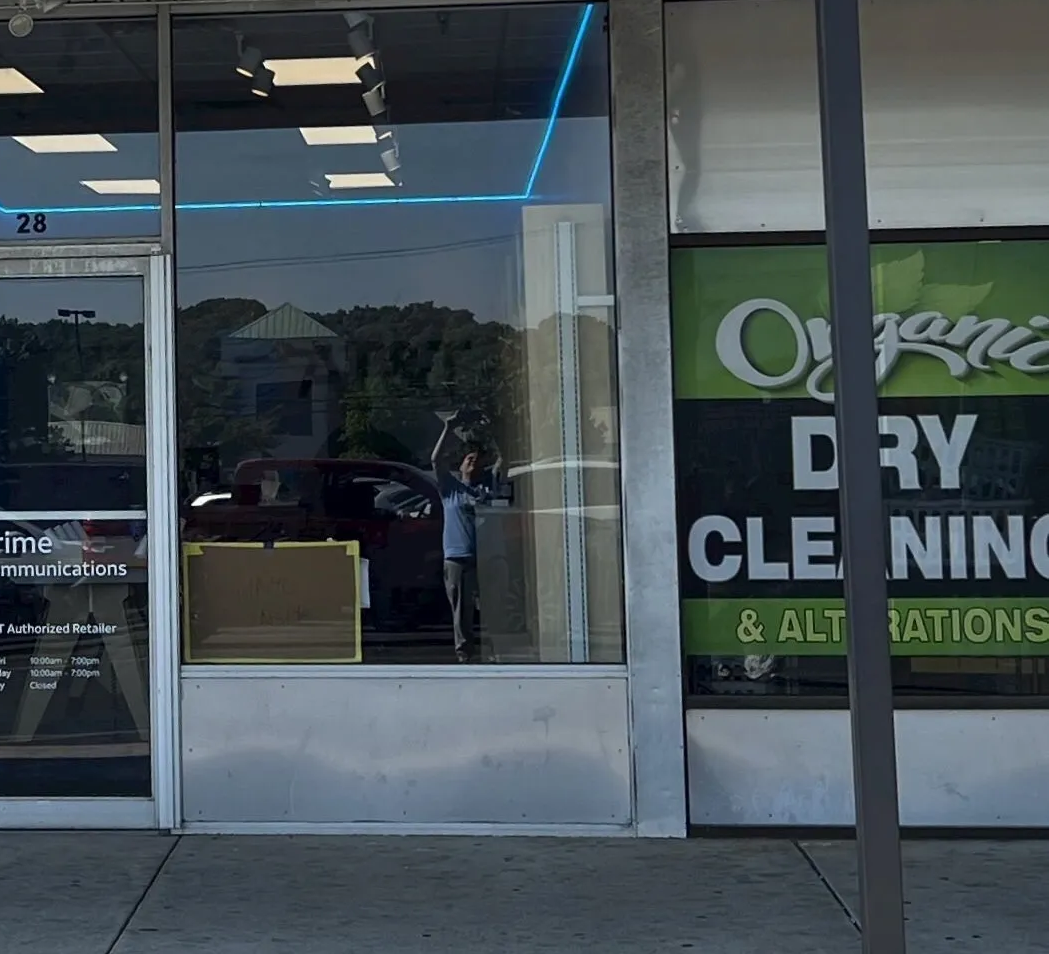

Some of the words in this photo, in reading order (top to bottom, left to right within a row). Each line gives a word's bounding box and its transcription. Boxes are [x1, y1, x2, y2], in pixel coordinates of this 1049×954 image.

[16, 212, 47, 234] 28
[790, 413, 979, 491] DRY
[688, 514, 1049, 582] CLENIN
[7, 623, 70, 634] Authorized
[72, 623, 117, 634] Retailer
[737, 609, 766, 643] &
[777, 607, 1049, 643] ALTRATIONS
[30, 656, 62, 665] 10:00am
[71, 656, 100, 666] 7:00pm
[30, 668, 62, 677] 10:00am
[71, 668, 100, 678] 7:00pm
[29, 680, 57, 690] Closed
